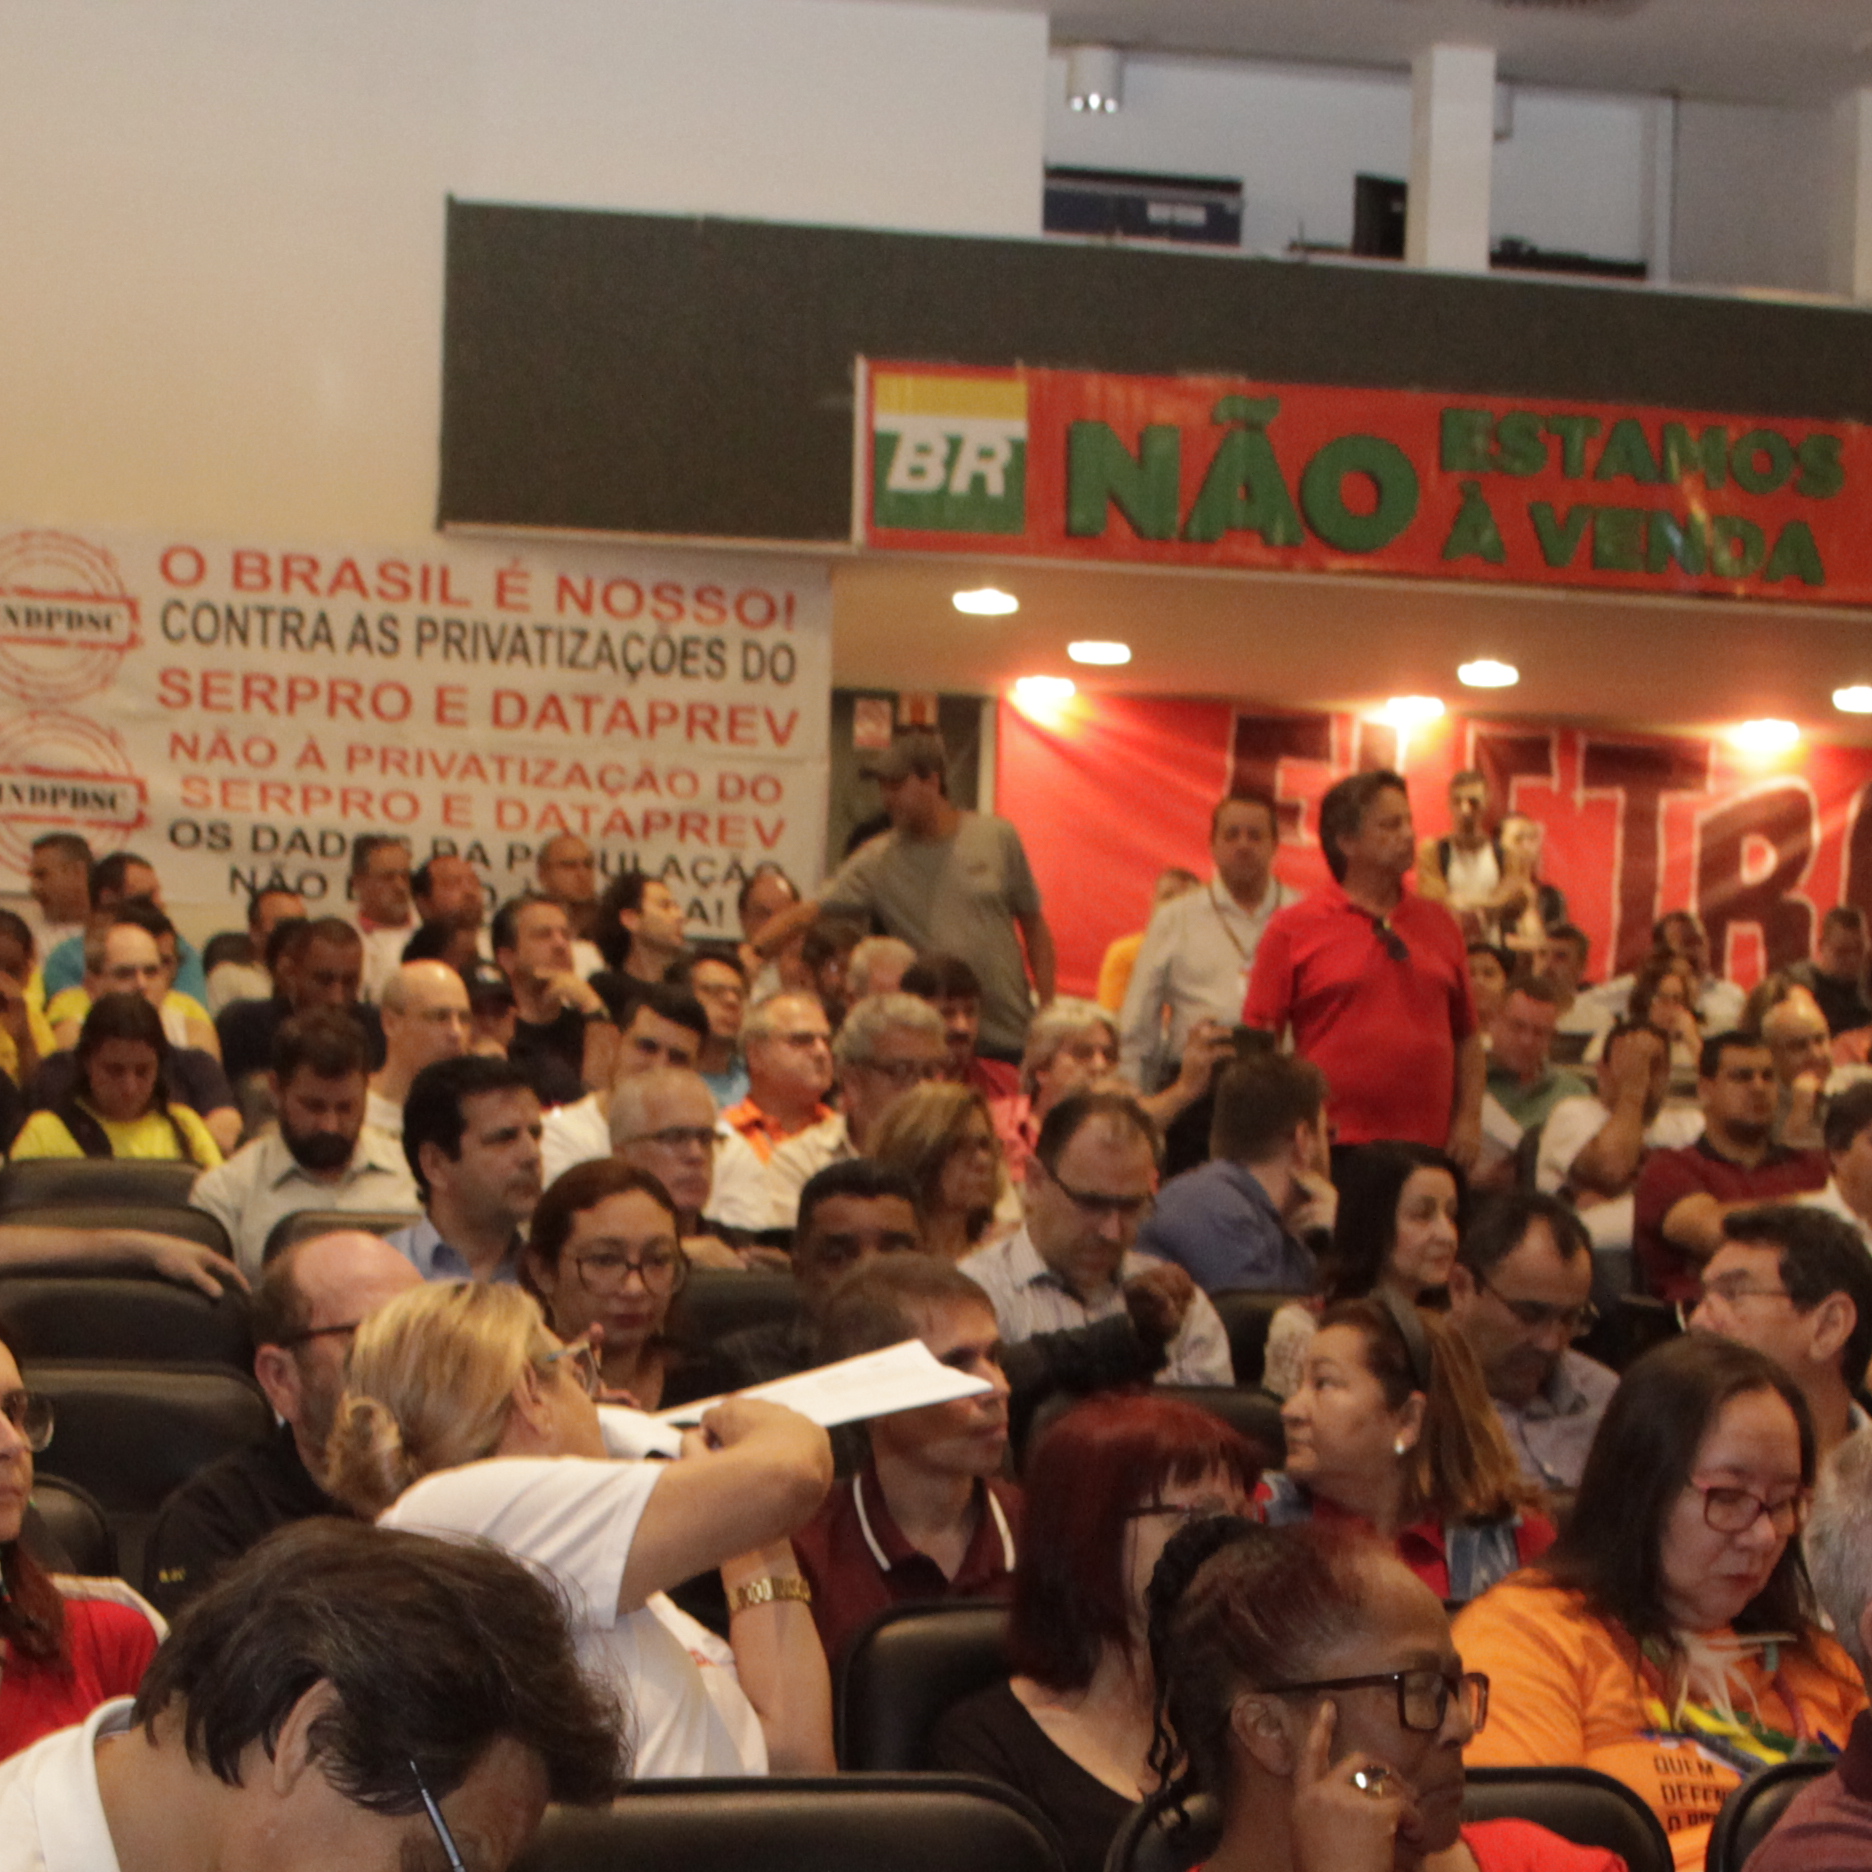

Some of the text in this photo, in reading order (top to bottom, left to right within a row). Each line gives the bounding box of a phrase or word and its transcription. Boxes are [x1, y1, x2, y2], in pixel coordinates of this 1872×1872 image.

[886, 431, 1012, 496] BR
[1066, 394, 1420, 553] NÃO
[1440, 407, 1846, 500] ESTAMOS
[1442, 481, 1507, 564] À
[1529, 500, 1826, 586] VENDA
[159, 545, 797, 632] O BRASIL É NOSSO!
[161, 599, 798, 685] CONTRA AS PRIVATIZAÇÕES DO
[157, 667, 800, 748] SERPRO E DATAPREV
[169, 729, 783, 806] NÃO À PRIVATIZAÇÃO DO
[169, 819, 232, 852] OS
[252, 825, 380, 861] DAD
[181, 775, 787, 850] SERPRO E DATAPREV
[230, 866, 327, 900] NÃO
[1654, 1755, 1715, 1778] QUEM
[1660, 1783, 1727, 1804] DEFEN
